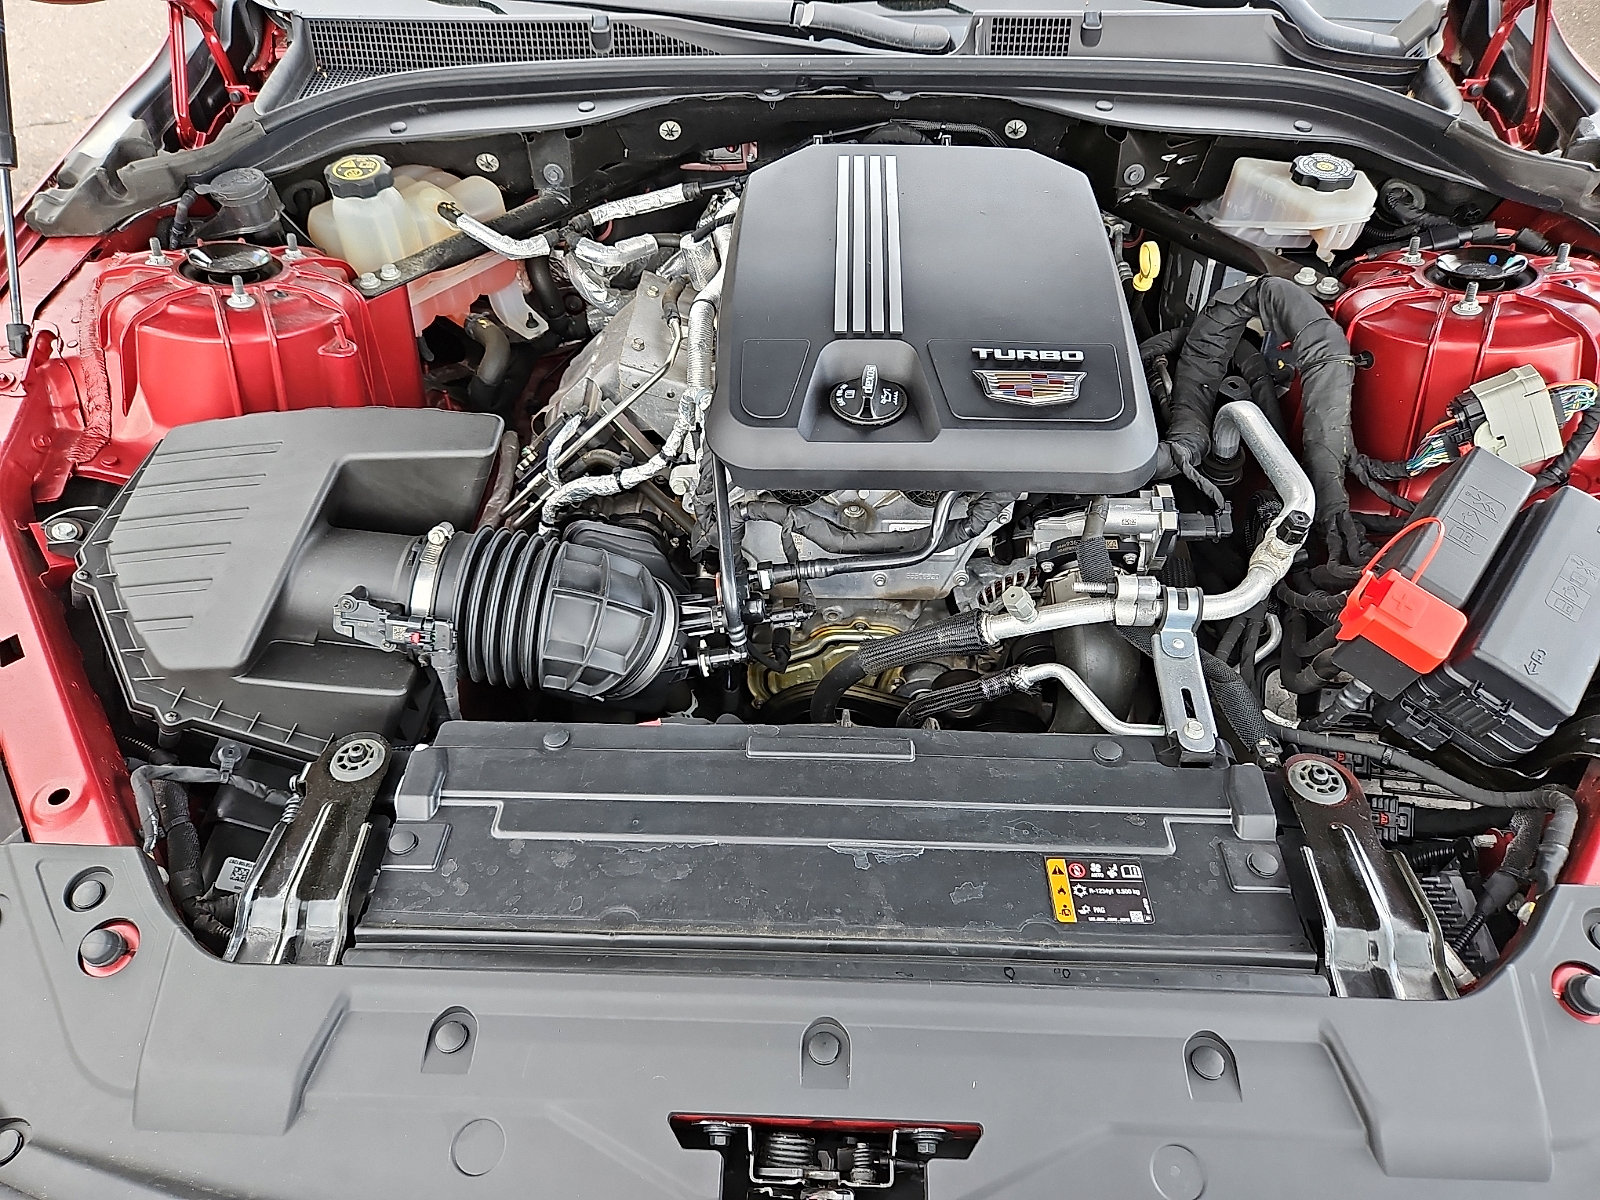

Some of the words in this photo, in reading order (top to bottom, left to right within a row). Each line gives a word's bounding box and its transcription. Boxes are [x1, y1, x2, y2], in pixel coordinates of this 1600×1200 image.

[972, 348, 1084, 362] TURBO
[862, 365, 876, 394] dexos
[1089, 888, 1114, 896] R-1234yf
[1132, 888, 1141, 896] kg
[1093, 906, 1106, 914] PAG
